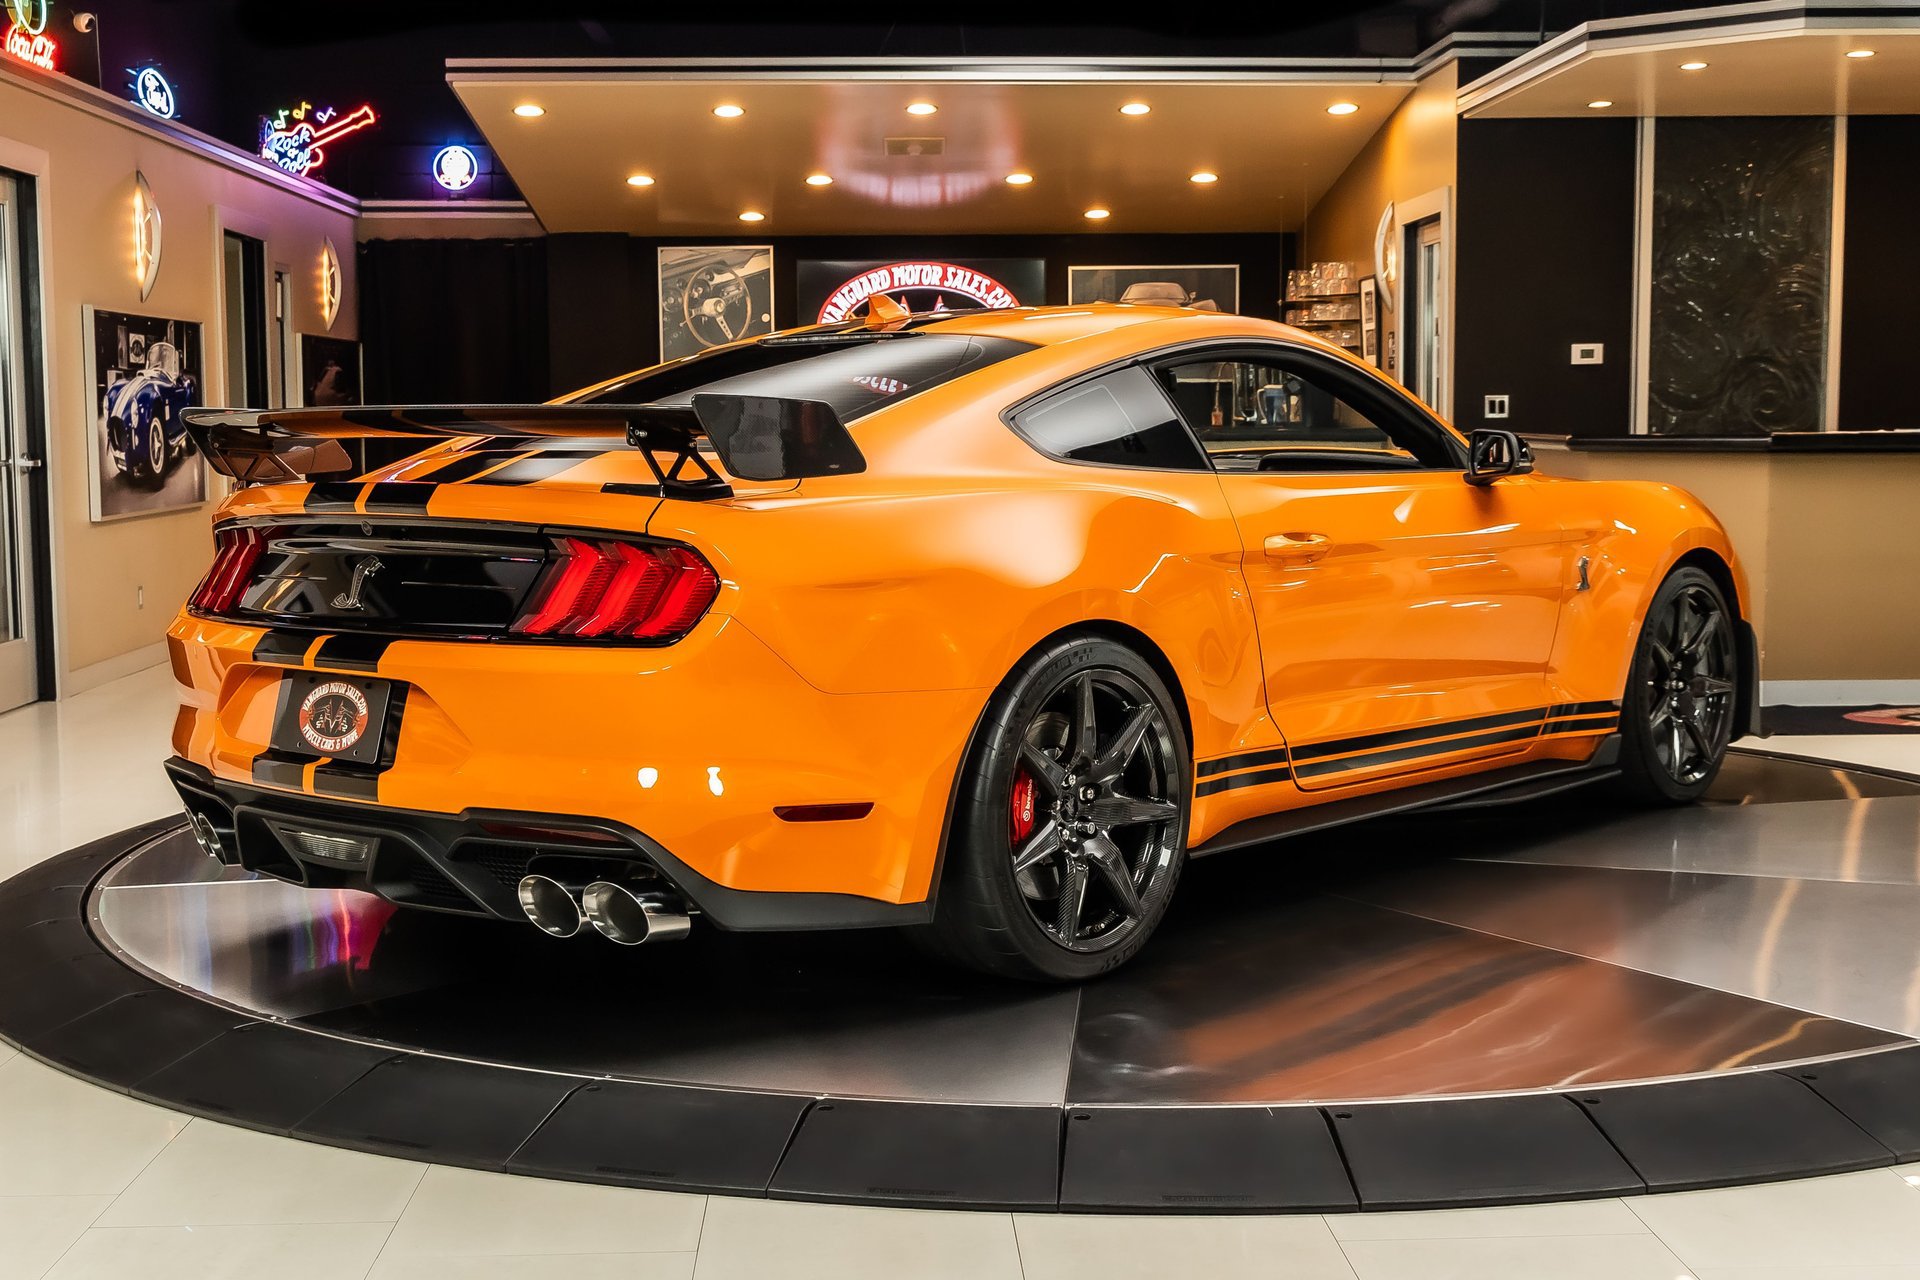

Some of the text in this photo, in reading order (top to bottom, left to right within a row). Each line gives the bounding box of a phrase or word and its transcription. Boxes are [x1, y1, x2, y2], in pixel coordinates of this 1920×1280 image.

[274, 126, 311, 153] Rock
[821, 264, 1015, 324] VANGUARD MOTOR SALES.CO
[302, 683, 330, 711] VANGUARD
[329, 682, 347, 693] MOTOR
[302, 723, 320, 747] MUSCLE
[320, 738, 335, 750] CARS
[341, 728, 359, 749] MORE
[1025, 779, 1033, 810] brembo
